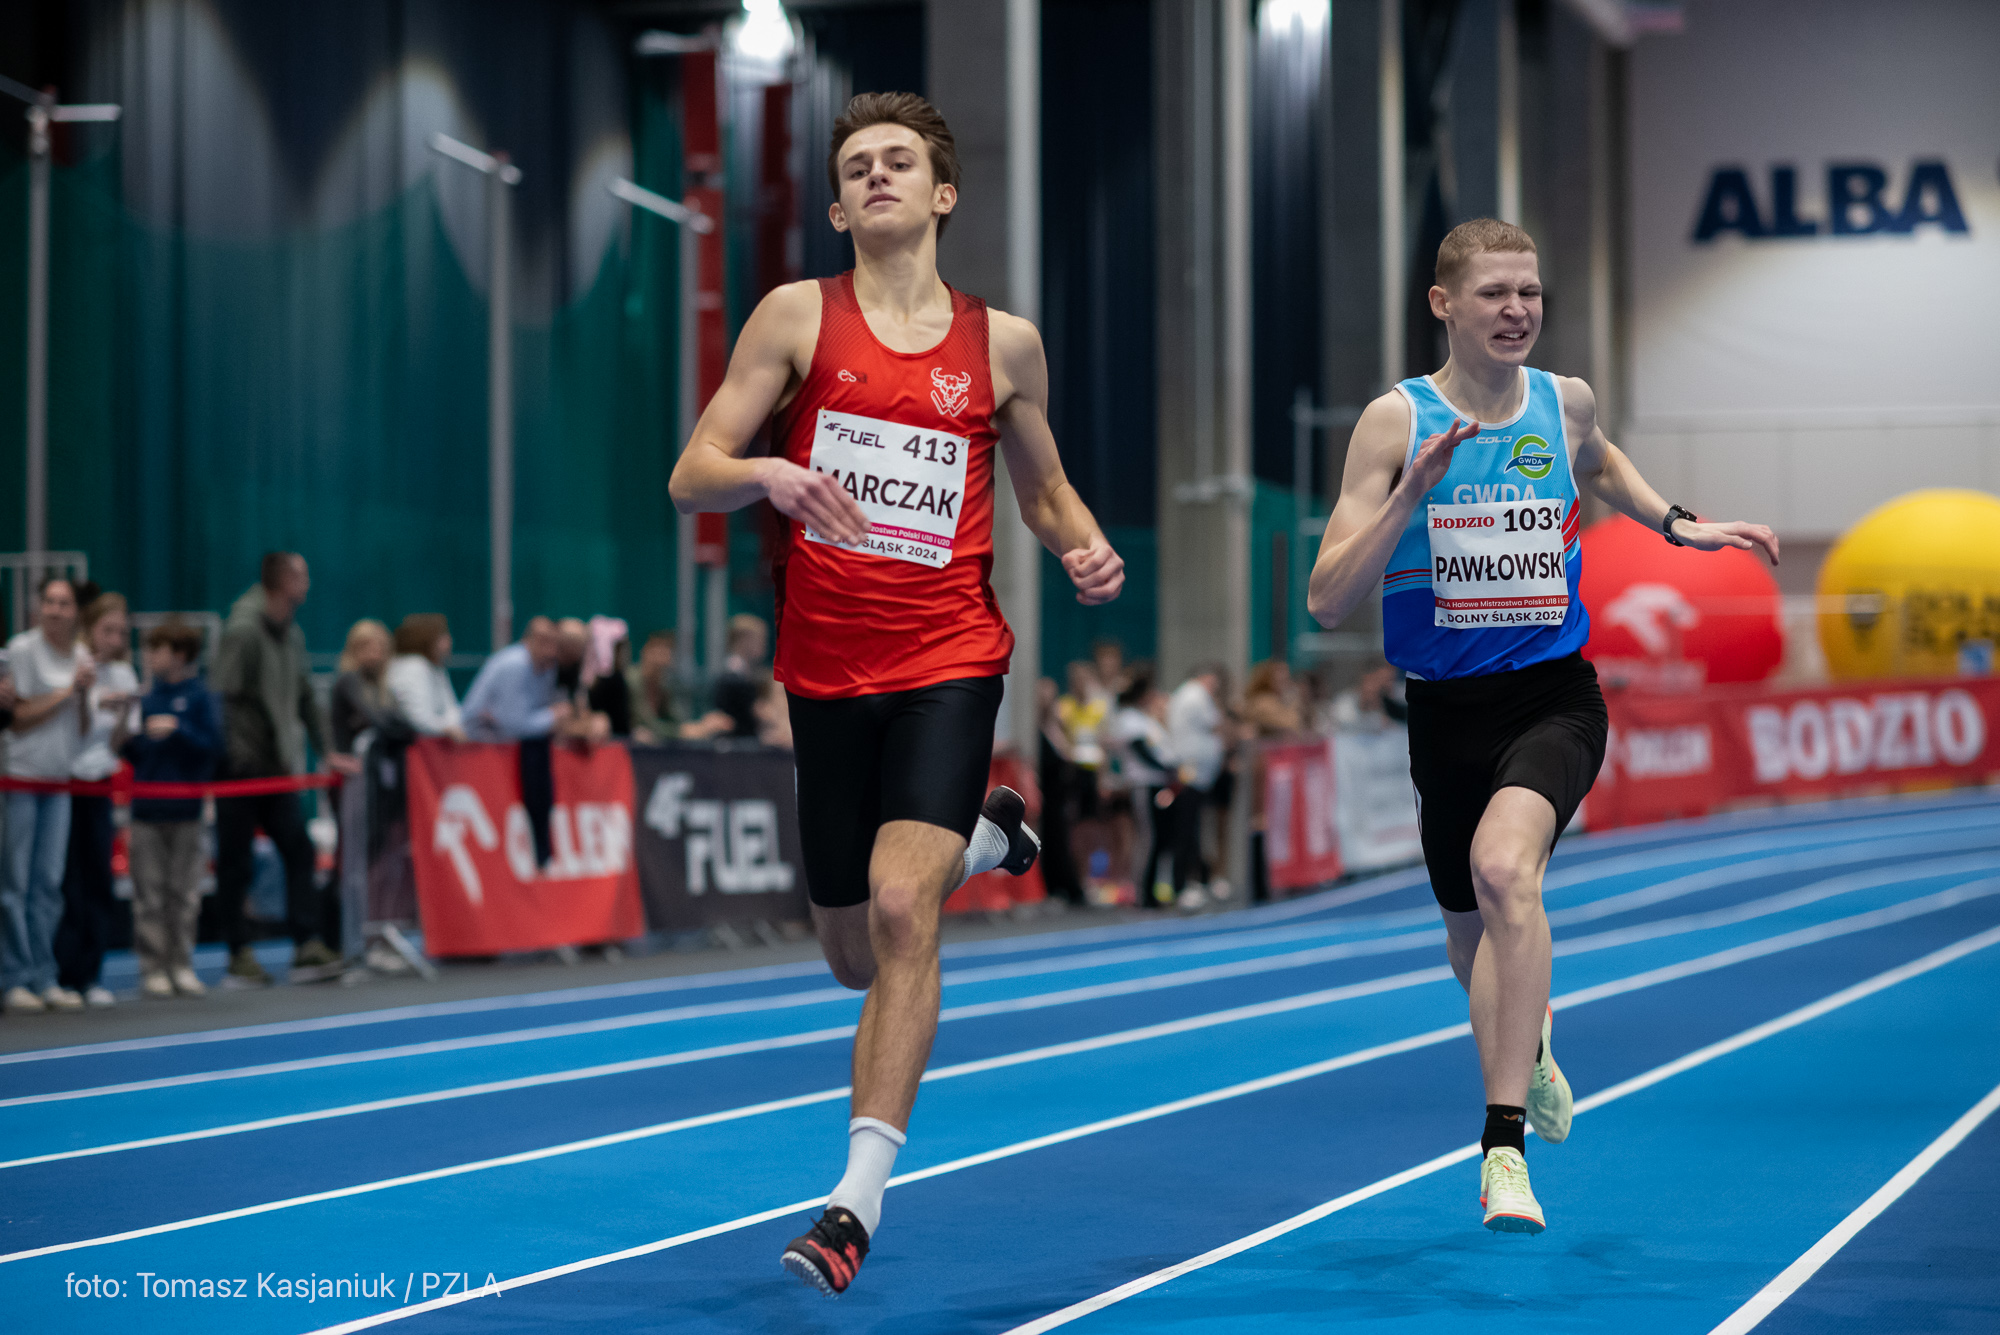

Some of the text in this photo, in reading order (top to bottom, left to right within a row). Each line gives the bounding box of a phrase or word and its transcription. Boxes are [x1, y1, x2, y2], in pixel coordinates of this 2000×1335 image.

[1694, 160, 1972, 241] ALBA
[837, 428, 886, 449] FUEL
[1476, 436, 1513, 444] COLO
[902, 435, 957, 466] 413
[1518, 457, 1543, 465] GWDA
[1452, 484, 1537, 505] GWDA
[1432, 516, 1495, 529] BODZIO
[898, 529, 921, 540] Polski
[921, 533, 934, 543] U18
[937, 535, 951, 546] U20
[907, 545, 938, 561] 2024
[1480, 599, 1522, 607] Mistrzostwa
[1524, 598, 1545, 606] Polski
[1447, 611, 1563, 623] DOLNY ŚLĄSK 2024
[1747, 688, 1985, 783] BODZIO
[685, 802, 794, 894] FUEL
